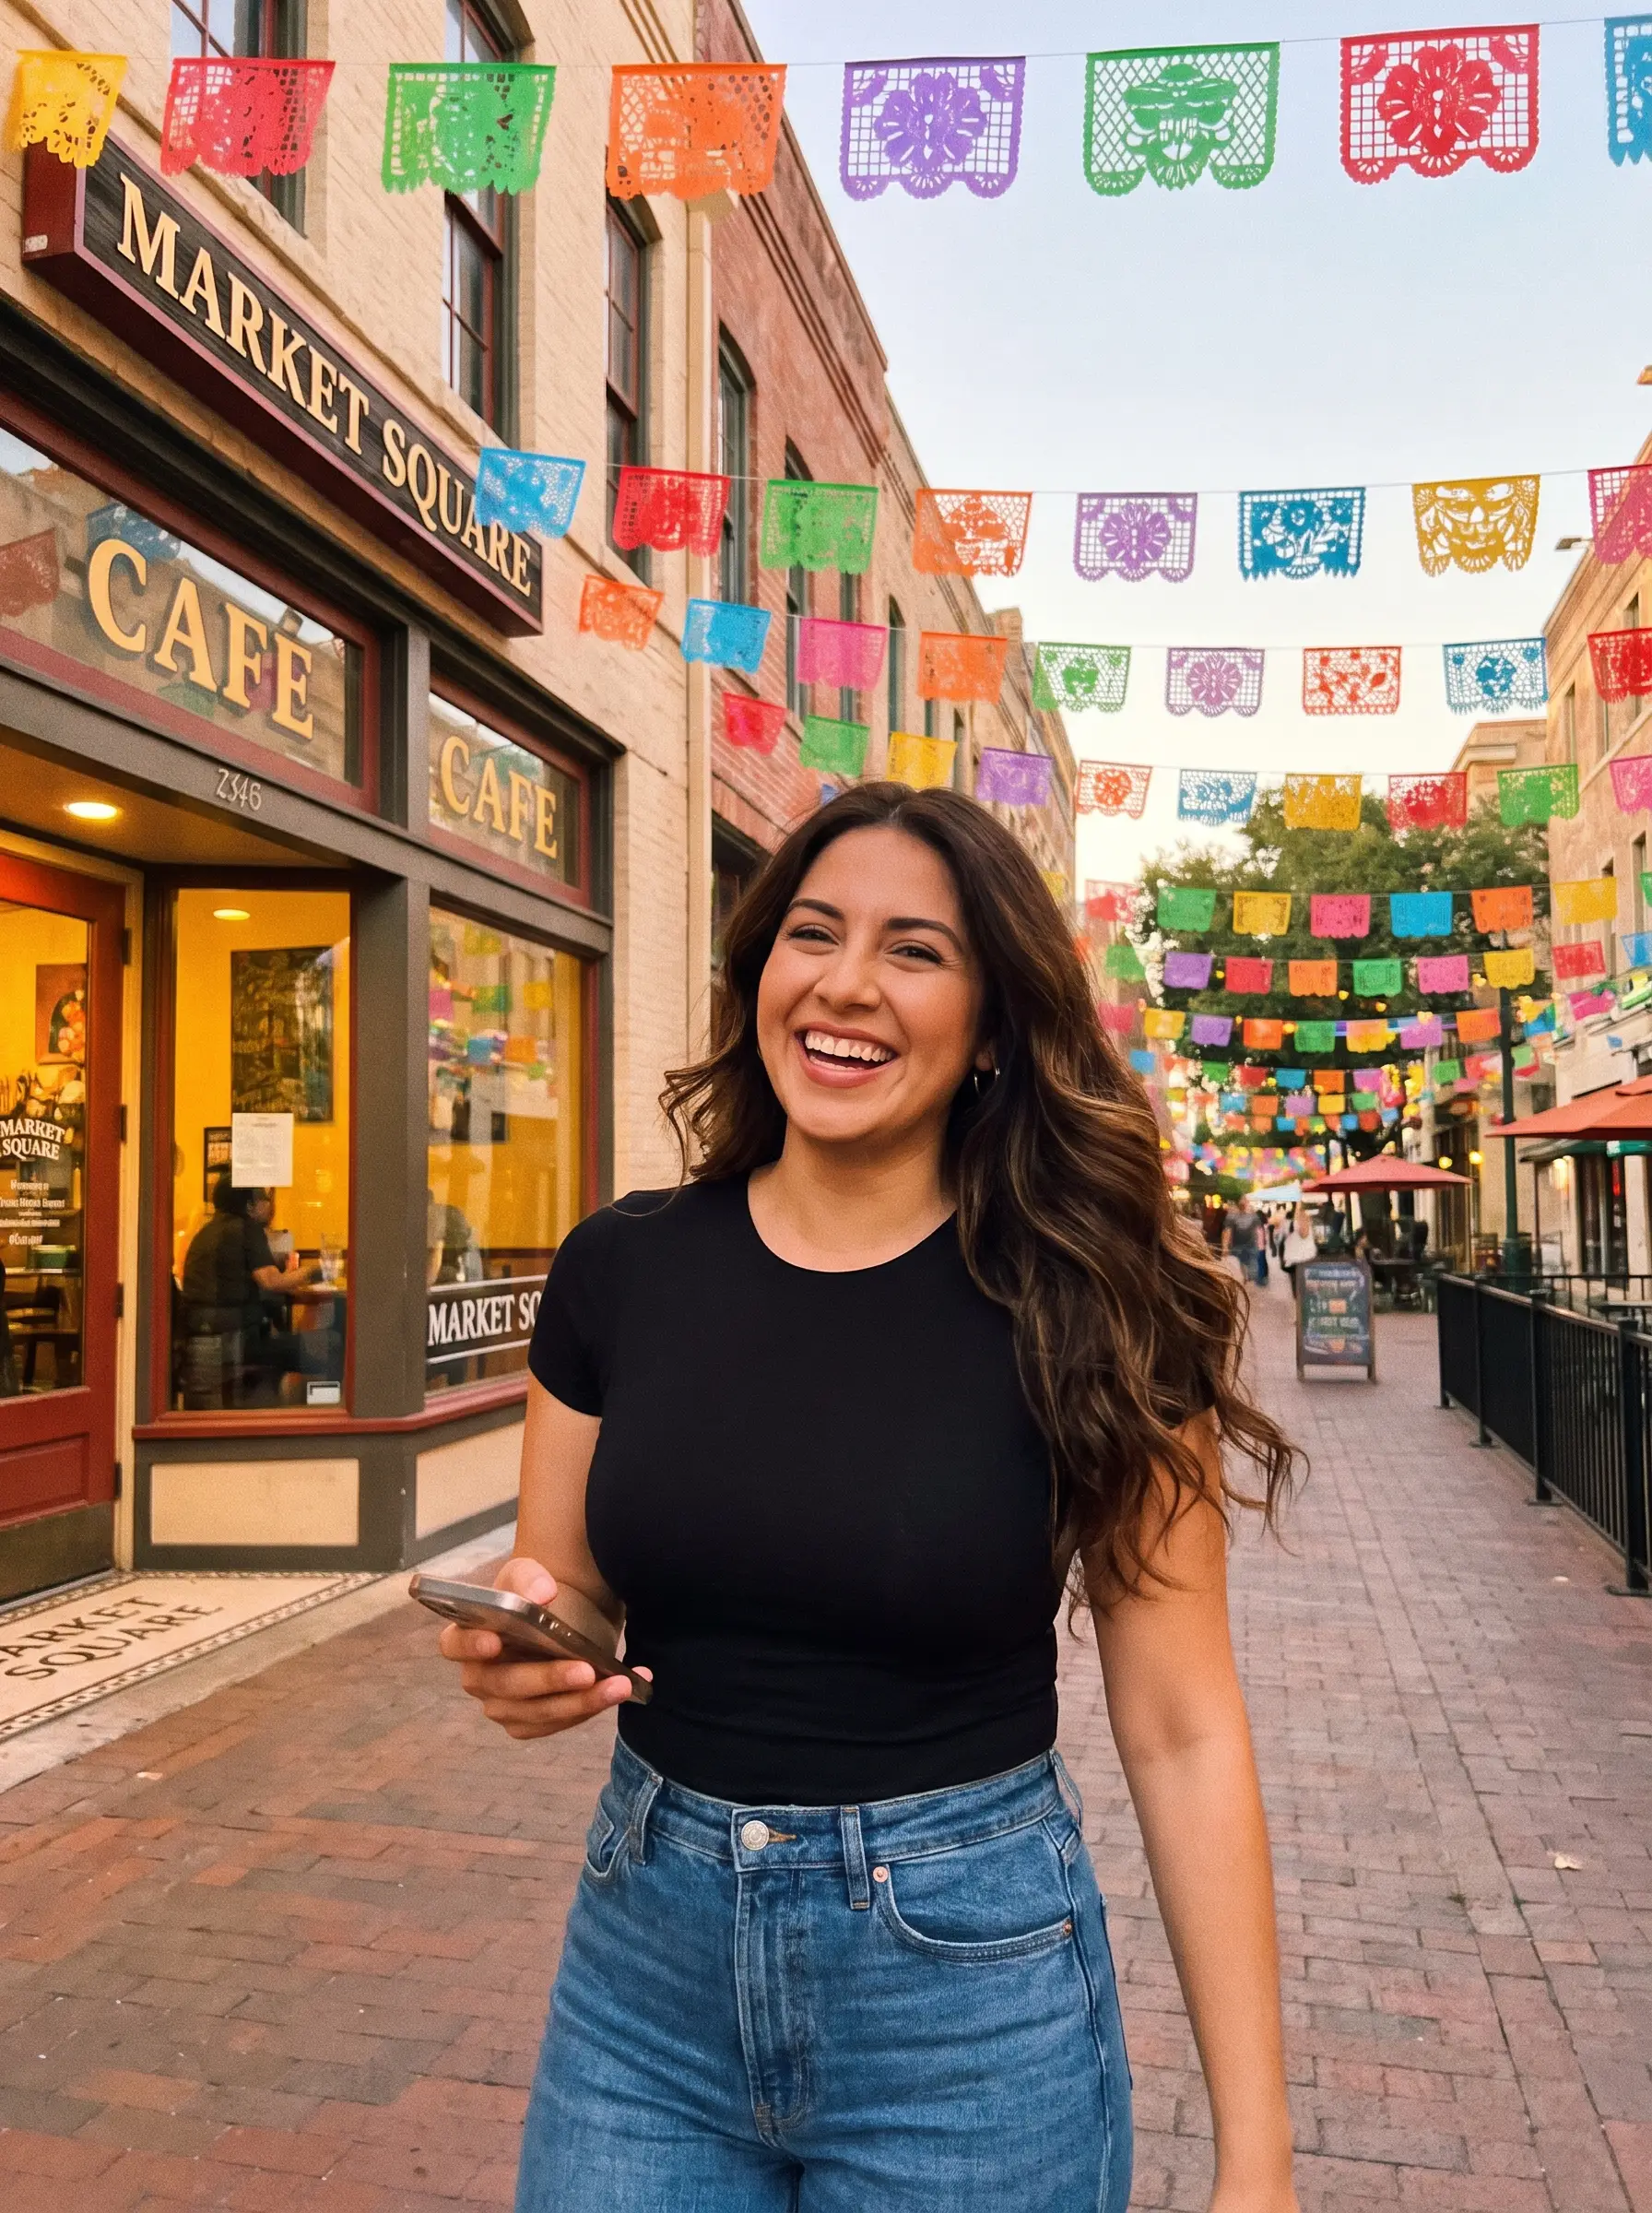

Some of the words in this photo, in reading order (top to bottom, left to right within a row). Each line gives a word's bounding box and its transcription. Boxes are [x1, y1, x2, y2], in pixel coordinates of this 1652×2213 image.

[117, 172, 370, 456] MARKET
[383, 419, 532, 598] SQUARE
[441, 735, 558, 859] CAFE
[0, 1118, 65, 1143] MARKET
[2, 1137, 60, 1161] SQUARE
[427, 1294, 516, 1347] MARKET
[0, 1595, 164, 1663] ARKET
[4, 1604, 224, 1680] SQUARE
